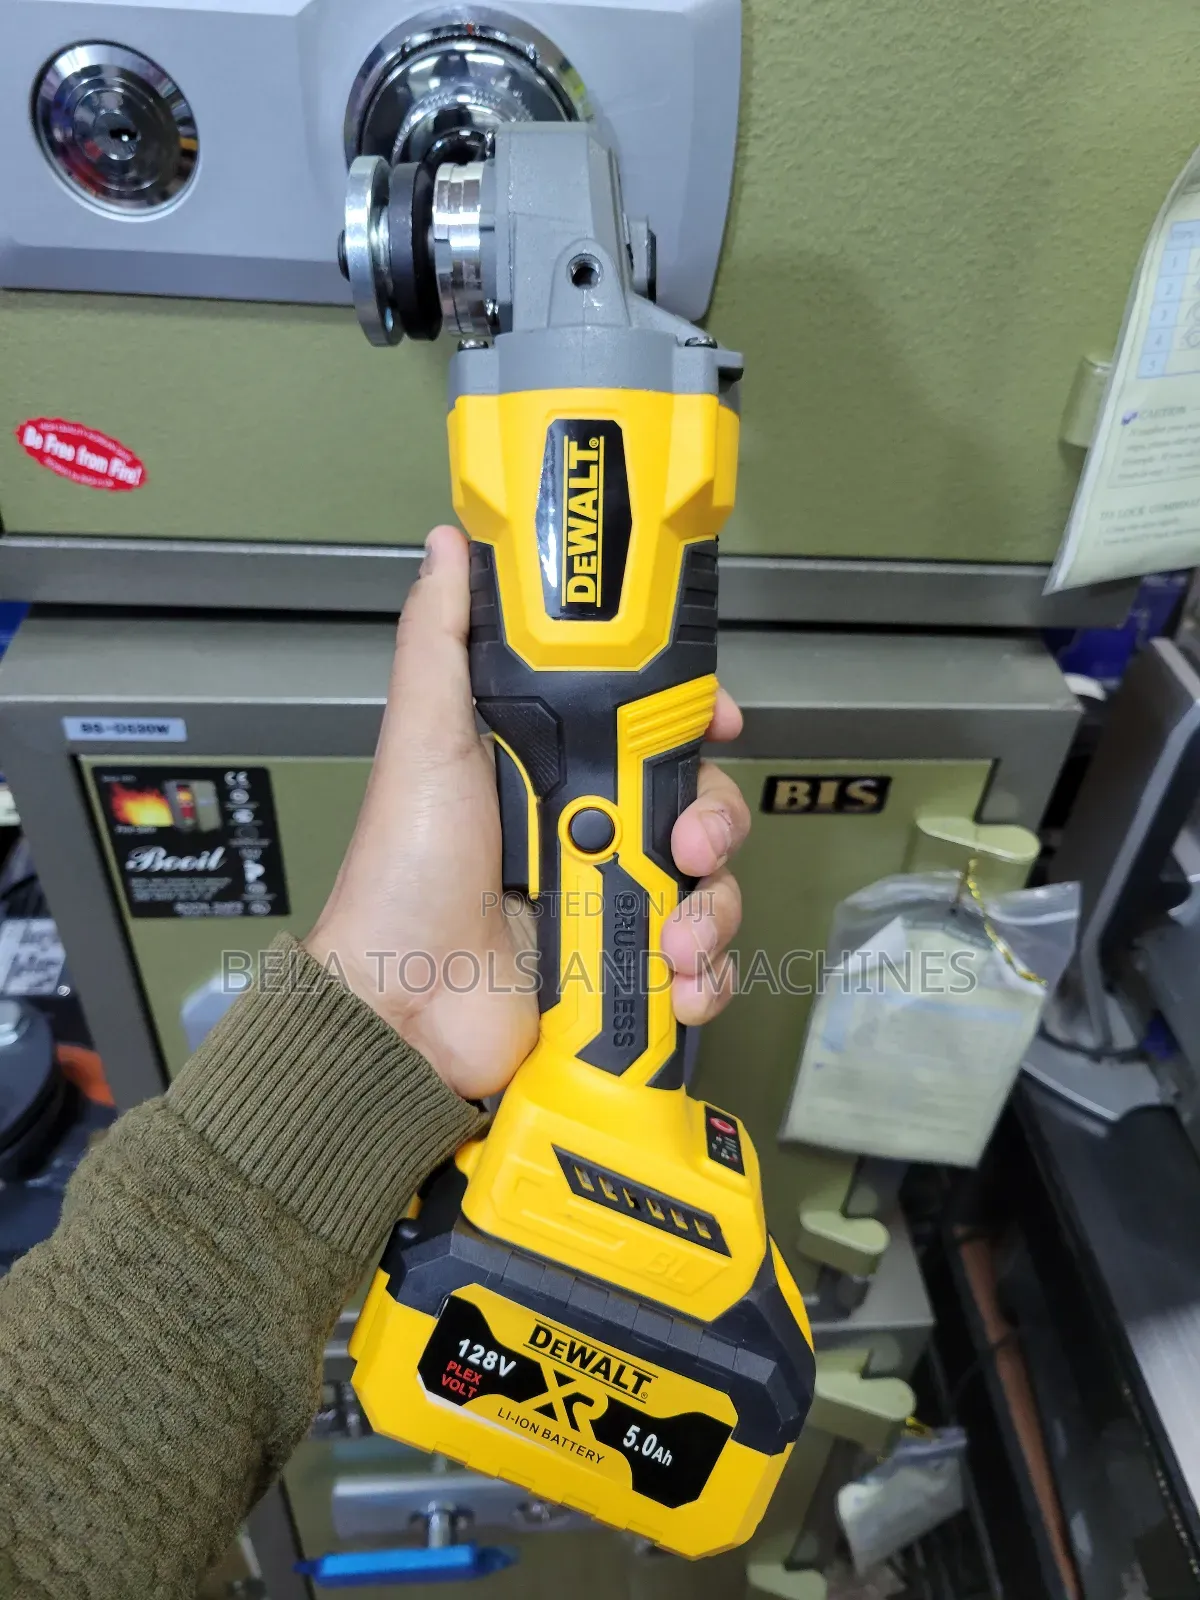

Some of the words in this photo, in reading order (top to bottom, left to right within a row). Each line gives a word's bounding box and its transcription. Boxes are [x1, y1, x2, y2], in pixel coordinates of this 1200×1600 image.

[76, 444, 109, 474] from
[771, 779, 881, 814] BIS
[446, 1360, 483, 1386] PLEX
[458, 1338, 518, 1378] 128V
[441, 1373, 478, 1399] VOLT
[529, 1363, 606, 1434] XR
[496, 1406, 540, 1435] LI-ION
[541, 1427, 606, 1465] BATTERY
[622, 1423, 674, 1467] 5.0Ah
